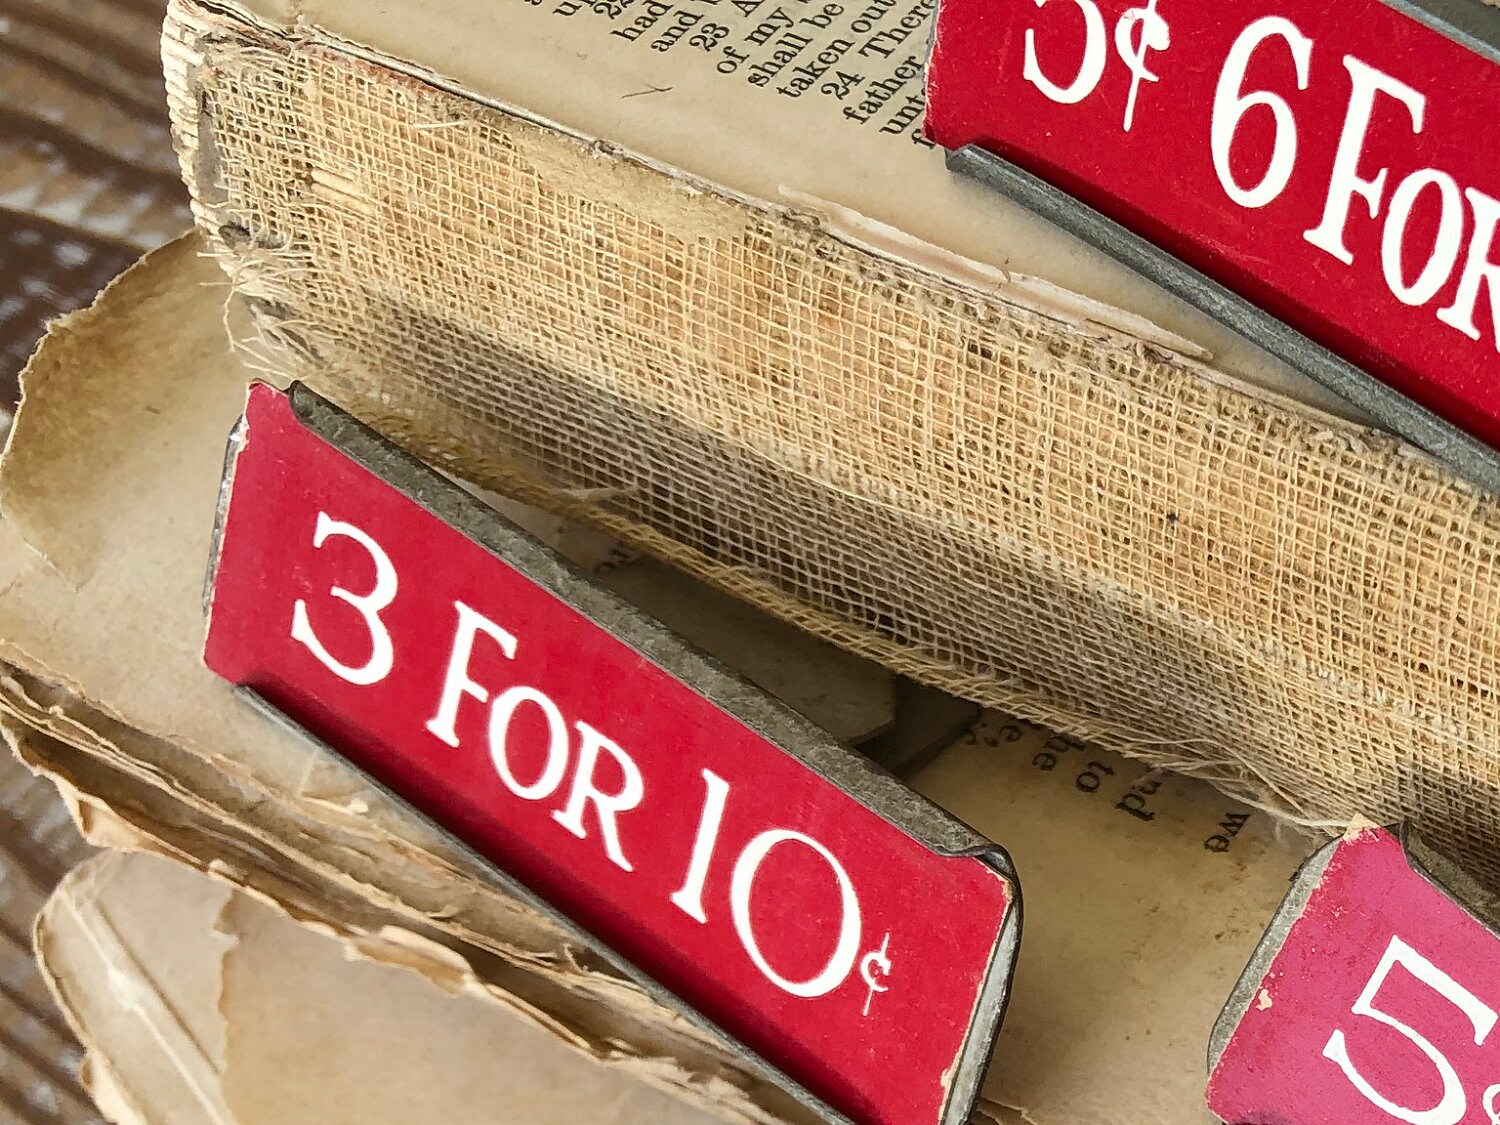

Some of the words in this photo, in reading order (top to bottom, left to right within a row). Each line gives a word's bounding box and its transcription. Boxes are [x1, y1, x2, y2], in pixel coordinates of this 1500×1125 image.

[609, 0, 675, 42] had
[650, 9, 705, 52] and
[688, 22, 730, 52] 23
[716, 45, 750, 74] of
[742, 6, 794, 46] my
[747, 31, 814, 87] shall
[799, 3, 844, 29] be
[775, 38, 856, 97] taken
[820, 70, 865, 100] 24
[842, 55, 925, 124] father
[1210, 15, 1314, 208] 6
[291, 511, 399, 686] 3
[671, 768, 892, 1017] 10¢
